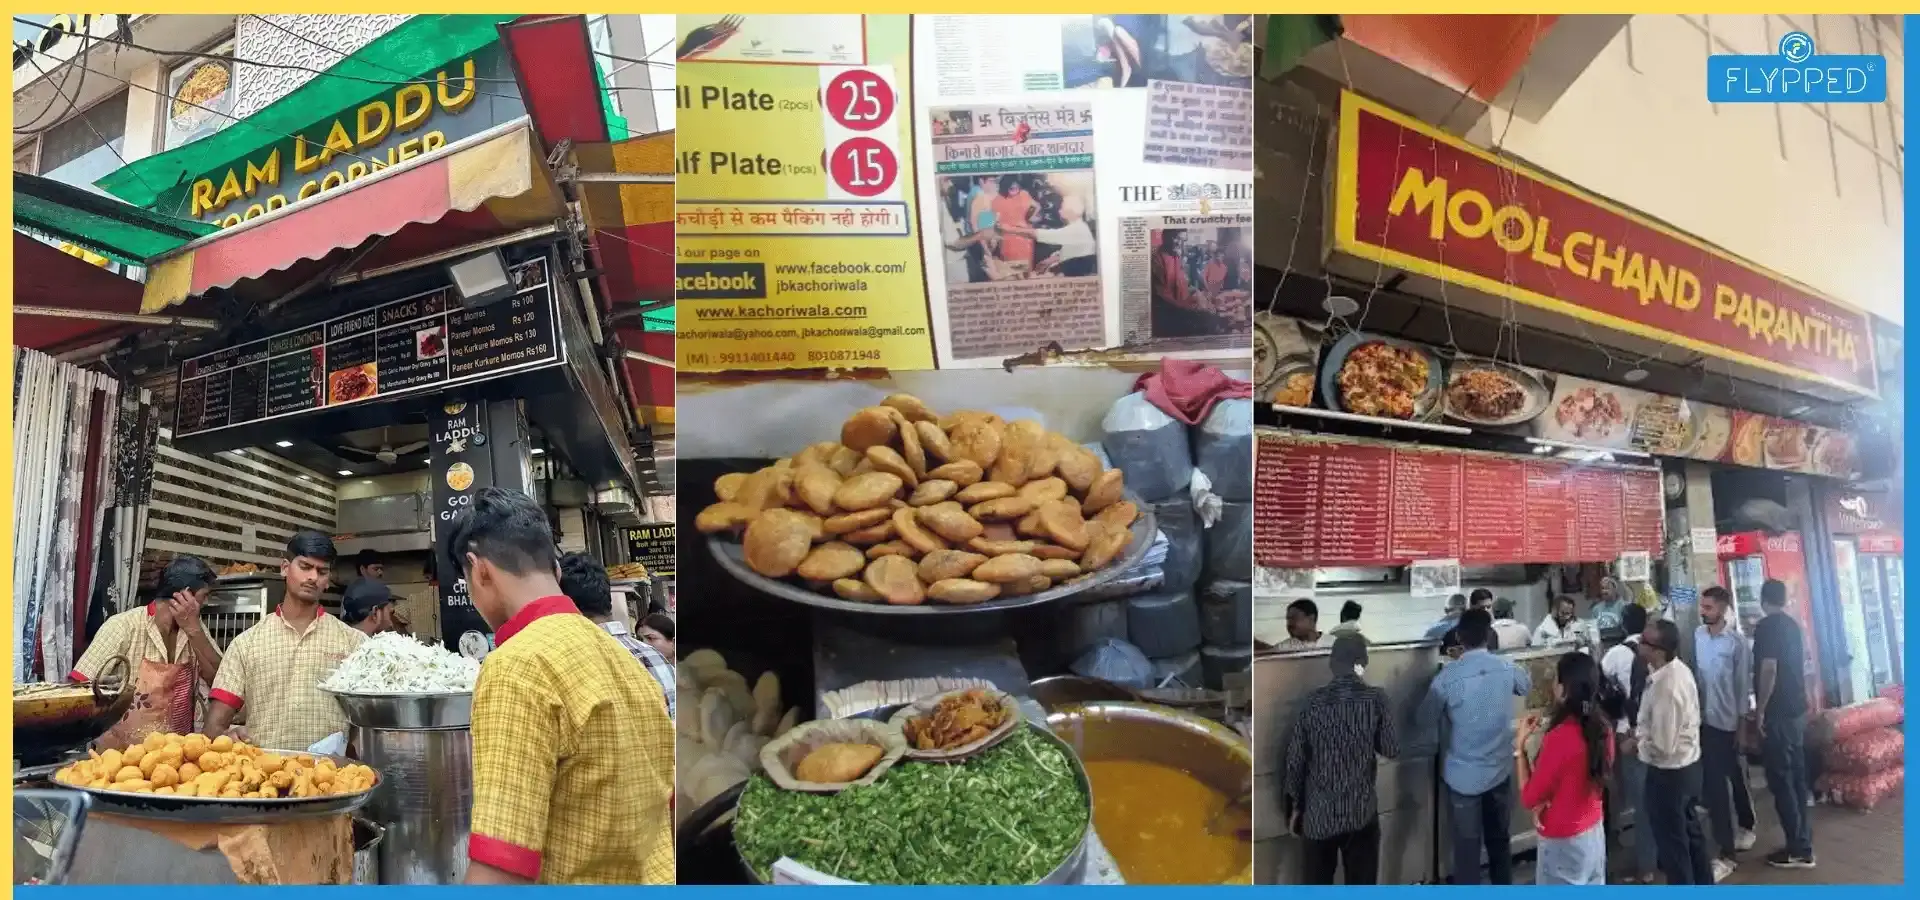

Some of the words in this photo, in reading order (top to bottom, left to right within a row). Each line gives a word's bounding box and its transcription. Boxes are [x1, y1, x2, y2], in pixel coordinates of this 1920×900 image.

[701, 85, 774, 111] Plate
[778, 98, 814, 113] (2pcs)
[841, 80, 882, 121] 25
[190, 146, 281, 219] RAM
[293, 57, 477, 175] LADDU
[710, 151, 782, 176] Plate
[783, 163, 817, 176] (1pcs)
[847, 148, 884, 187] 15
[1118, 185, 1162, 202] THE
[730, 207, 744, 227] से
[749, 211, 777, 226] कम
[782, 207, 826, 227] पैकिंग
[1162, 215, 1186, 226] That
[1189, 213, 1234, 226] crunchy
[684, 249, 706, 259] our
[709, 248, 741, 262] page
[744, 248, 761, 258] on
[775, 261, 907, 276] www.facebook.com/
[1387, 166, 1702, 312] MOOLCHAND
[1712, 281, 1859, 373] PARANTHA
[776, 279, 868, 295] jbkachoriwala
[382, 302, 418, 323] SNACKS
[464, 309, 486, 320] Momos
[512, 299, 521, 309] Rs
[522, 295, 534, 306] 100
[696, 304, 868, 320] www.kachoriwala.com
[330, 323, 344, 337] LOVE
[344, 318, 362, 334] FRIEND
[450, 330, 471, 341] Paneer
[472, 322, 496, 335] Momos
[512, 316, 522, 325] Rs
[523, 311, 535, 322] 120
[801, 325, 926, 341] jbkachoriwala@gmail.com
[451, 347, 463, 357] Veg
[464, 341, 489, 353] Kurkure
[489, 335, 513, 347] Momos
[514, 332, 524, 341] Rs
[525, 328, 537, 338] 130
[452, 362, 473, 373] Paneer
[474, 355, 500, 368] Kurkure
[501, 350, 525, 361] Momos
[447, 417, 466, 430] RAM
[630, 529, 651, 541] RAM
